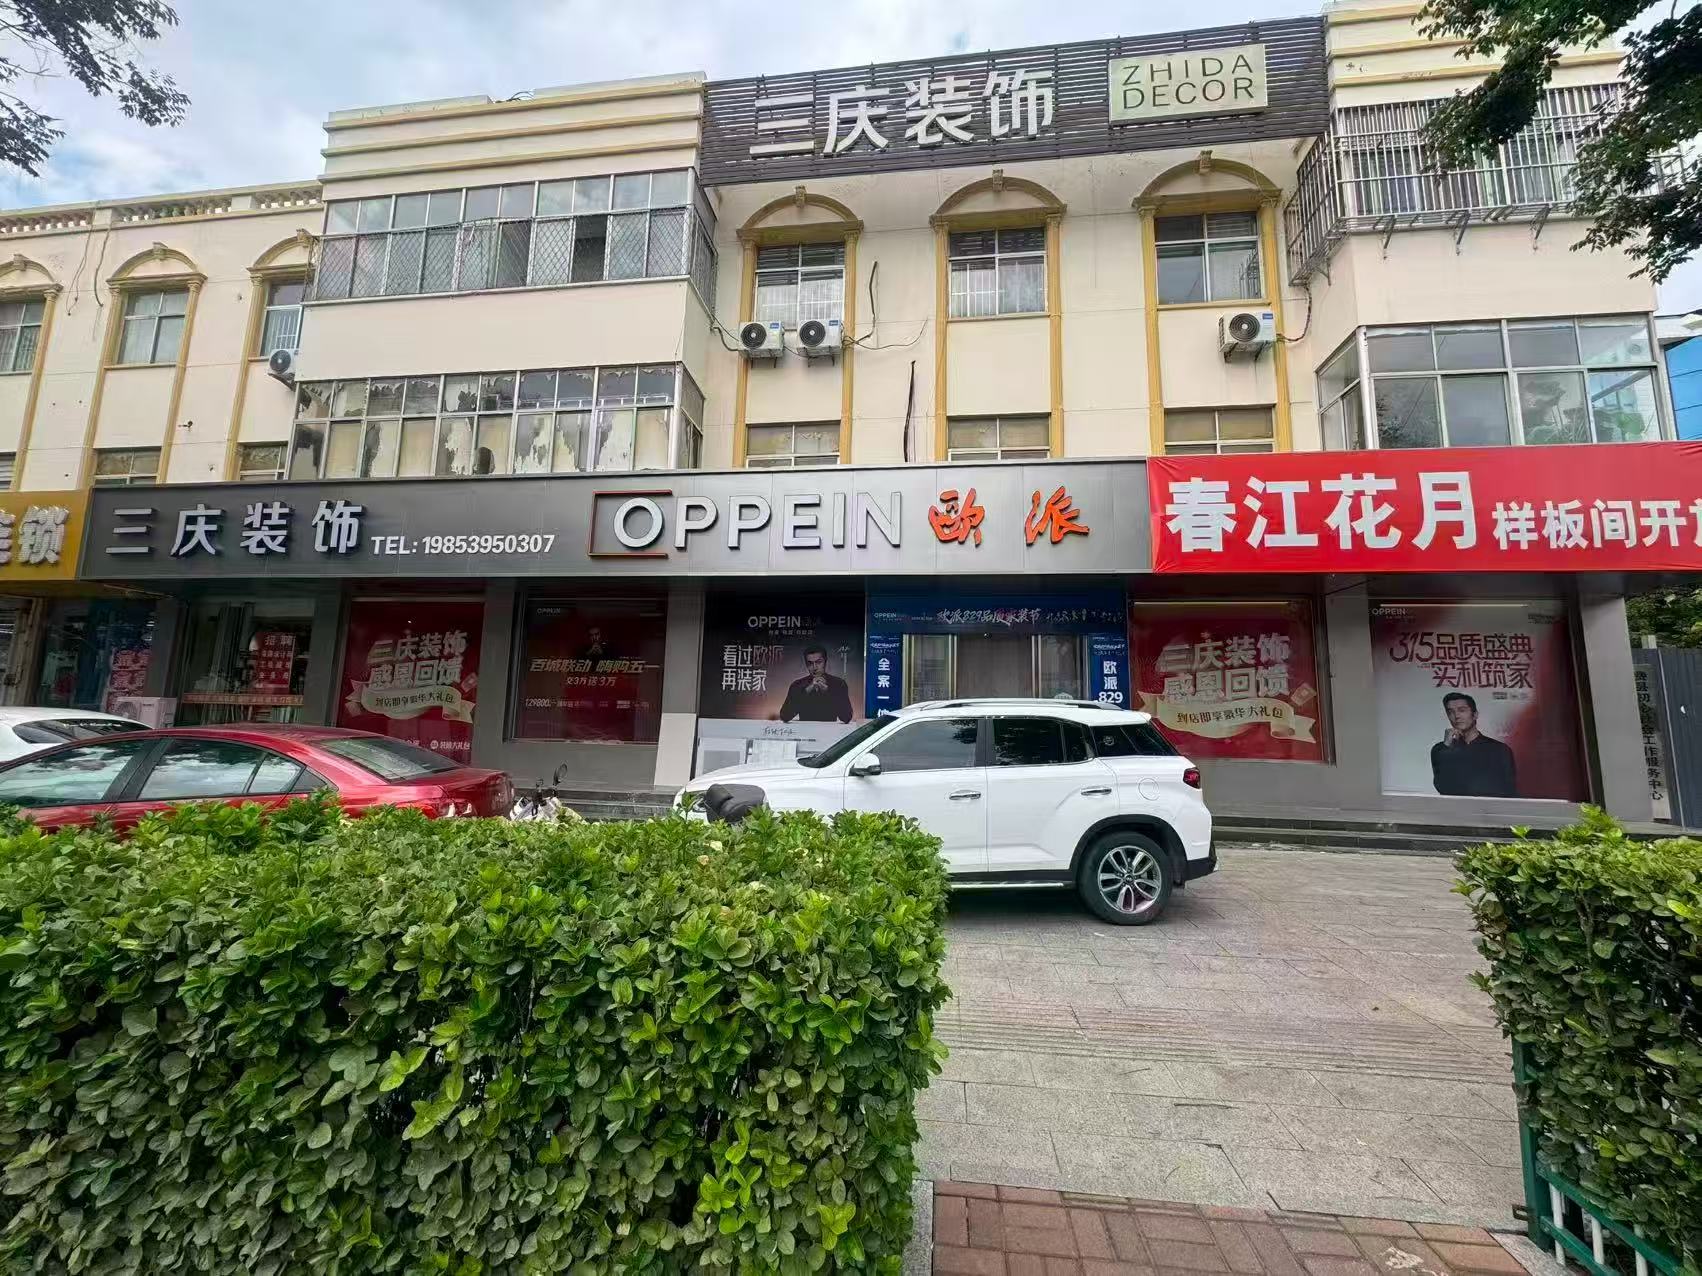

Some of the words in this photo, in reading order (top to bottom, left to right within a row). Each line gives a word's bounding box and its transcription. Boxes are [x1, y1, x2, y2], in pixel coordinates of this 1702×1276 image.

[1122, 54, 1252, 86] ZHIDA
[1123, 76, 1254, 110] DECOR
[750, 68, 1053, 156] 三庆装饰
[105, 500, 363, 557] 三庆装饰
[613, 491, 902, 550] OPPEIN
[1165, 470, 1479, 553] 春江花月
[1492, 497, 1702, 551] 样板间开
[747, 615, 801, 628] OPPEIN
[367, 629, 469, 665] 三庆装饰
[530, 657, 592, 673] 百城联动
[1156, 632, 1290, 673] 三庆装饰
[369, 656, 464, 689] 感恩回馈
[721, 668, 767, 691] 再装家
[1163, 665, 1290, 703] 感恩回馈
